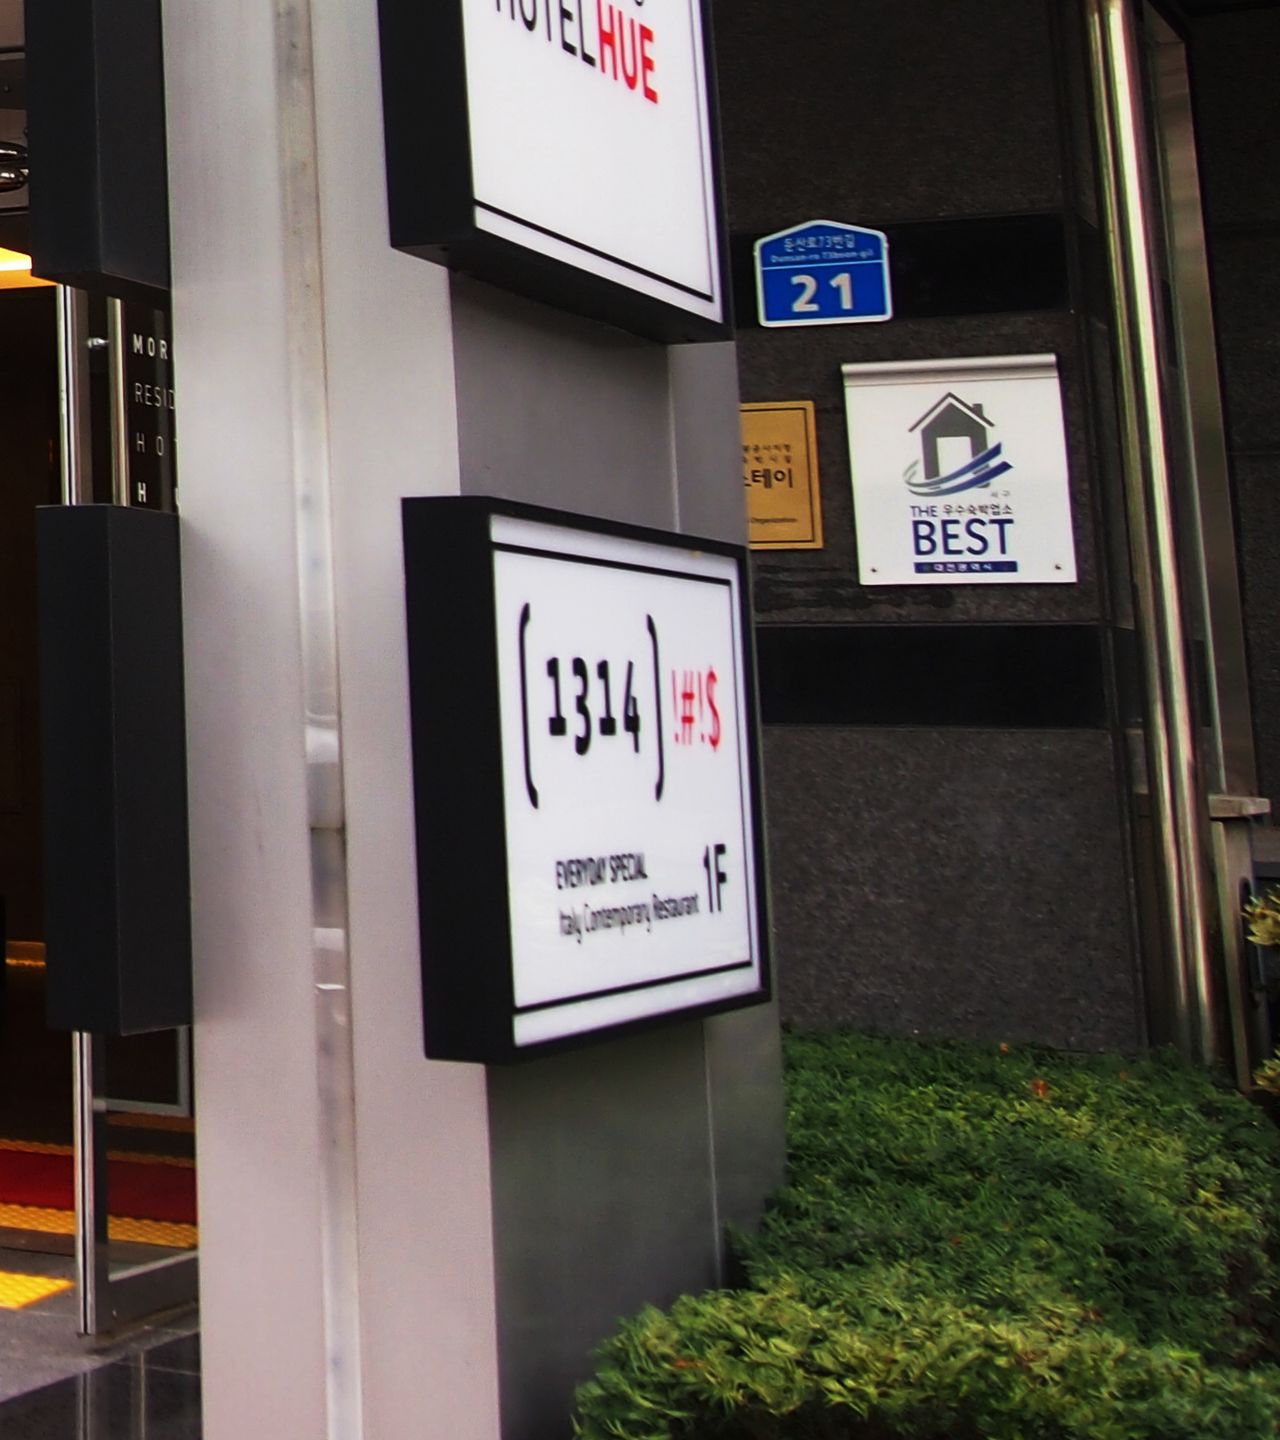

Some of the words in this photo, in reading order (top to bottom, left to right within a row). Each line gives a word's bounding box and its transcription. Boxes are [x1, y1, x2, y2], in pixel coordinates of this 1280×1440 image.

[790, 272, 854, 313] 21
[910, 505, 938, 517] THE
[912, 518, 1014, 556] BEST
[556, 857, 607, 890] EVERYDAY
[609, 852, 648, 883] SPECIAL
[703, 843, 727, 913] 1F
[559, 905, 582, 944] Italy
[583, 903, 652, 936] Contemporary
[652, 893, 700, 921] Restaurant
